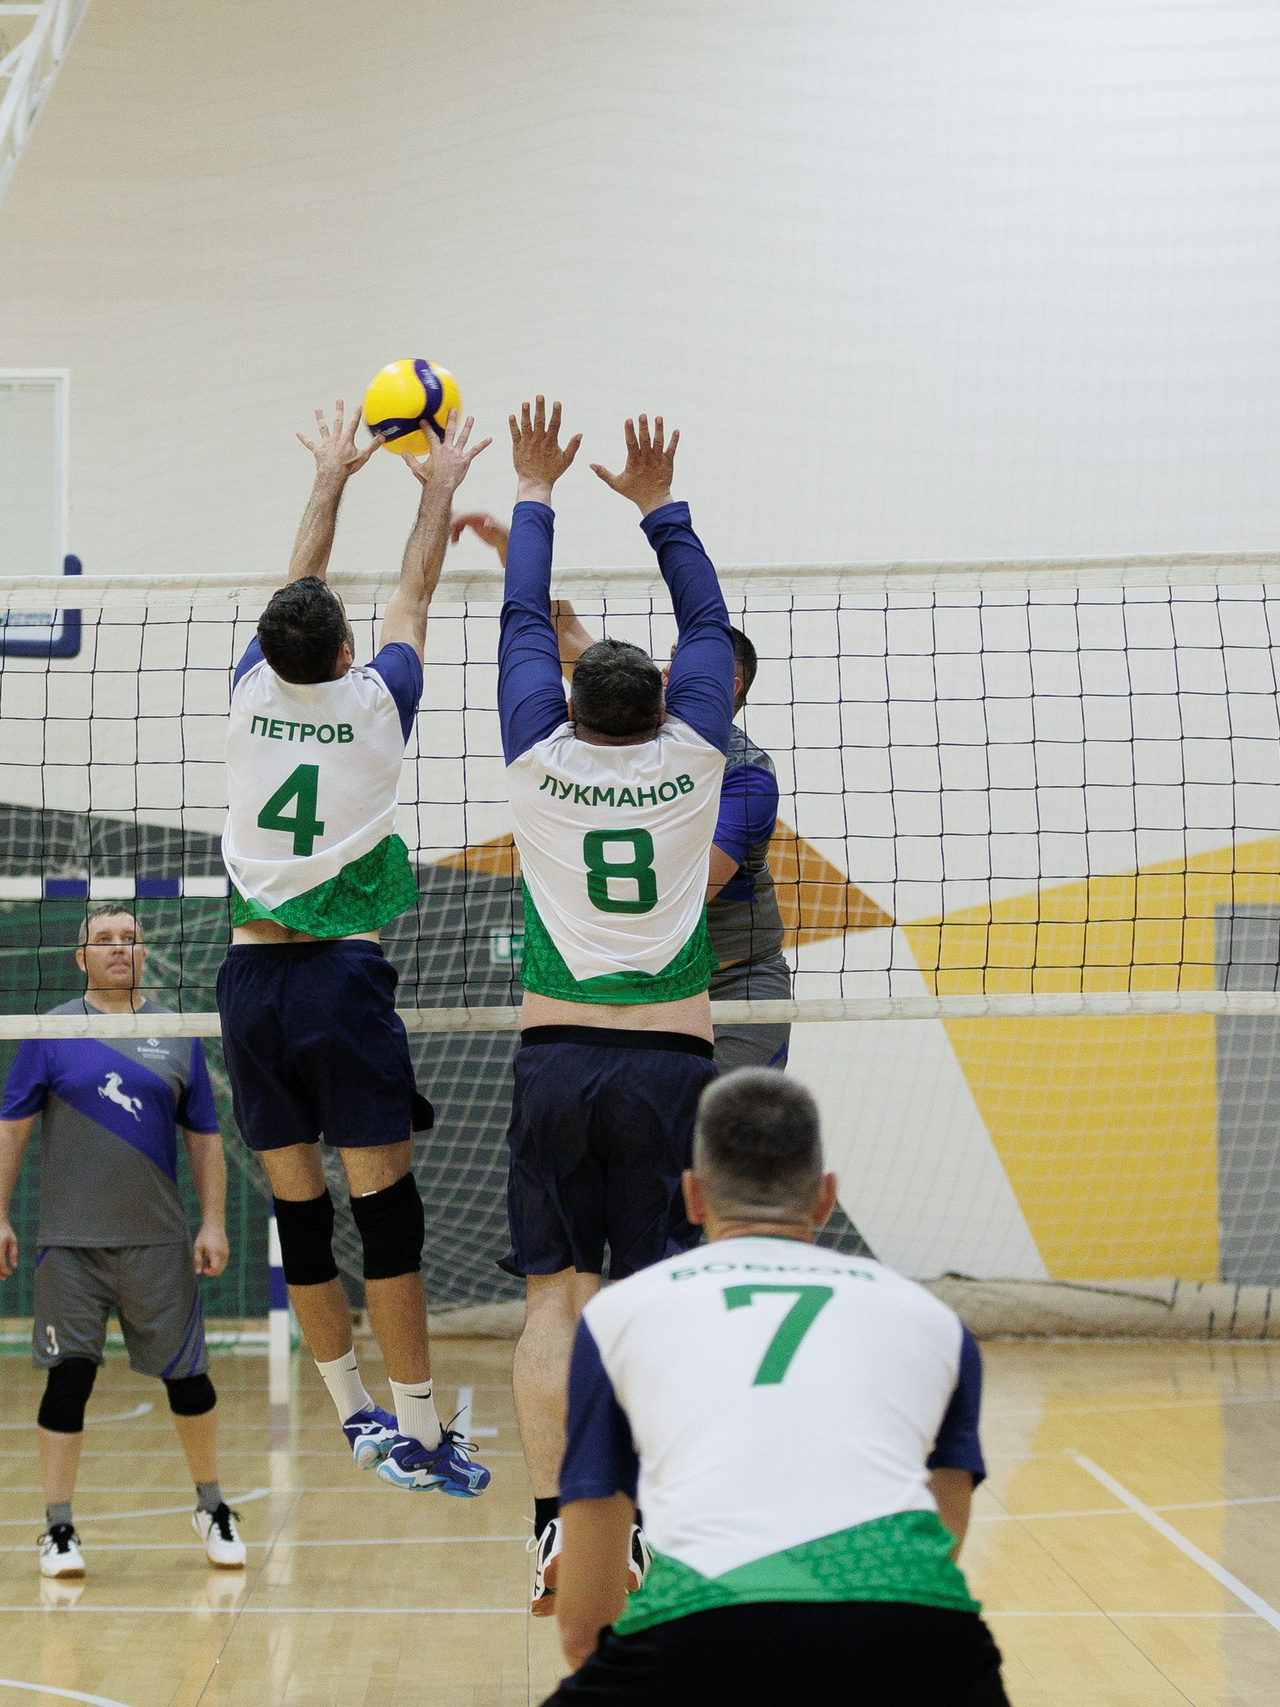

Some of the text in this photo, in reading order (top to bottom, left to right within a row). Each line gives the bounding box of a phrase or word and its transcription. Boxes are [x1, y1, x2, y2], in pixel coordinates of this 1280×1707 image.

[250, 714, 355, 744] ПЕТРОВ
[257, 763, 325, 857] 4
[539, 773, 695, 808] ЛУКМАНОВ
[583, 827, 658, 914] 8
[46, 1325, 59, 1356] 3
[723, 1284, 834, 1386] 7
